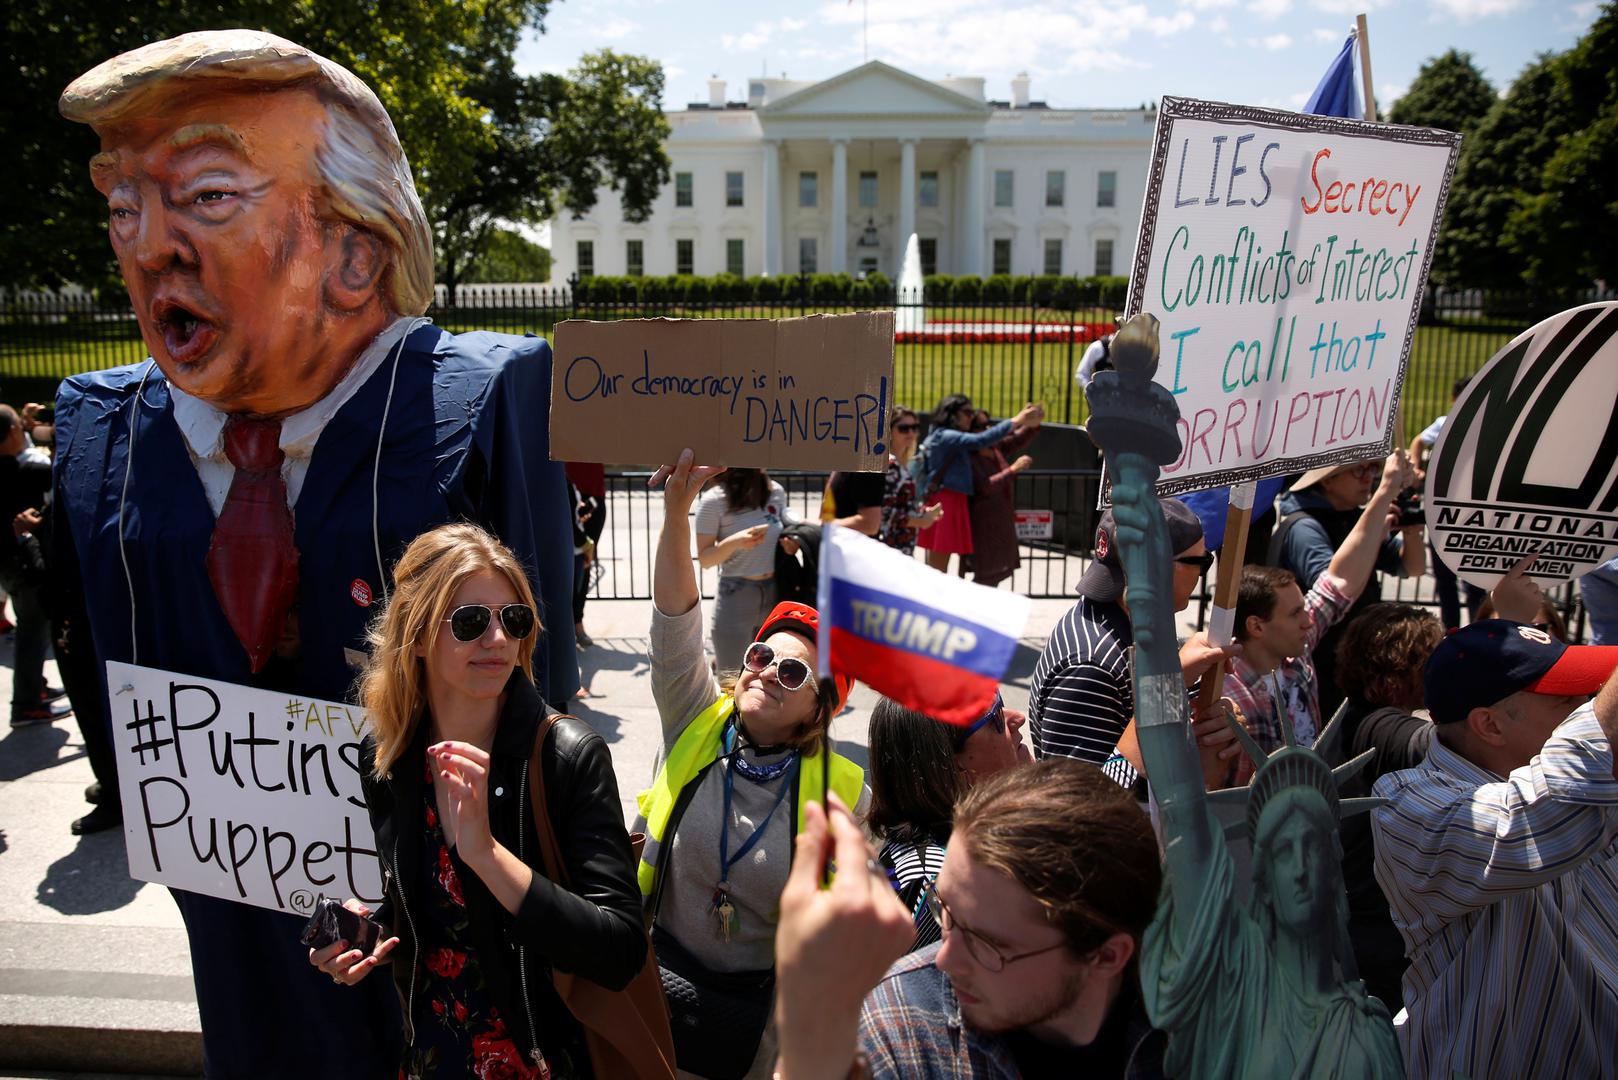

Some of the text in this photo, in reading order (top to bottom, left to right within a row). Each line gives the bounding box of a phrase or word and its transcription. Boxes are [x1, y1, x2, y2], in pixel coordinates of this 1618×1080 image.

[1174, 133, 1421, 226] LIES Secrecy
[1161, 225, 1419, 312] Conflicts of Interest
[565, 350, 795, 415] Our democracy is in
[1170, 315, 1386, 395] I call that
[743, 376, 887, 455] DANGER!
[1161, 378, 1391, 473] ORRUPTION
[1445, 533, 1605, 560] ORGANIZATION
[1460, 554, 1575, 574] FOR WMEN
[851, 601, 978, 660] TRUMP
[126, 681, 369, 809] #Putins
[139, 776, 386, 908] Puppet
